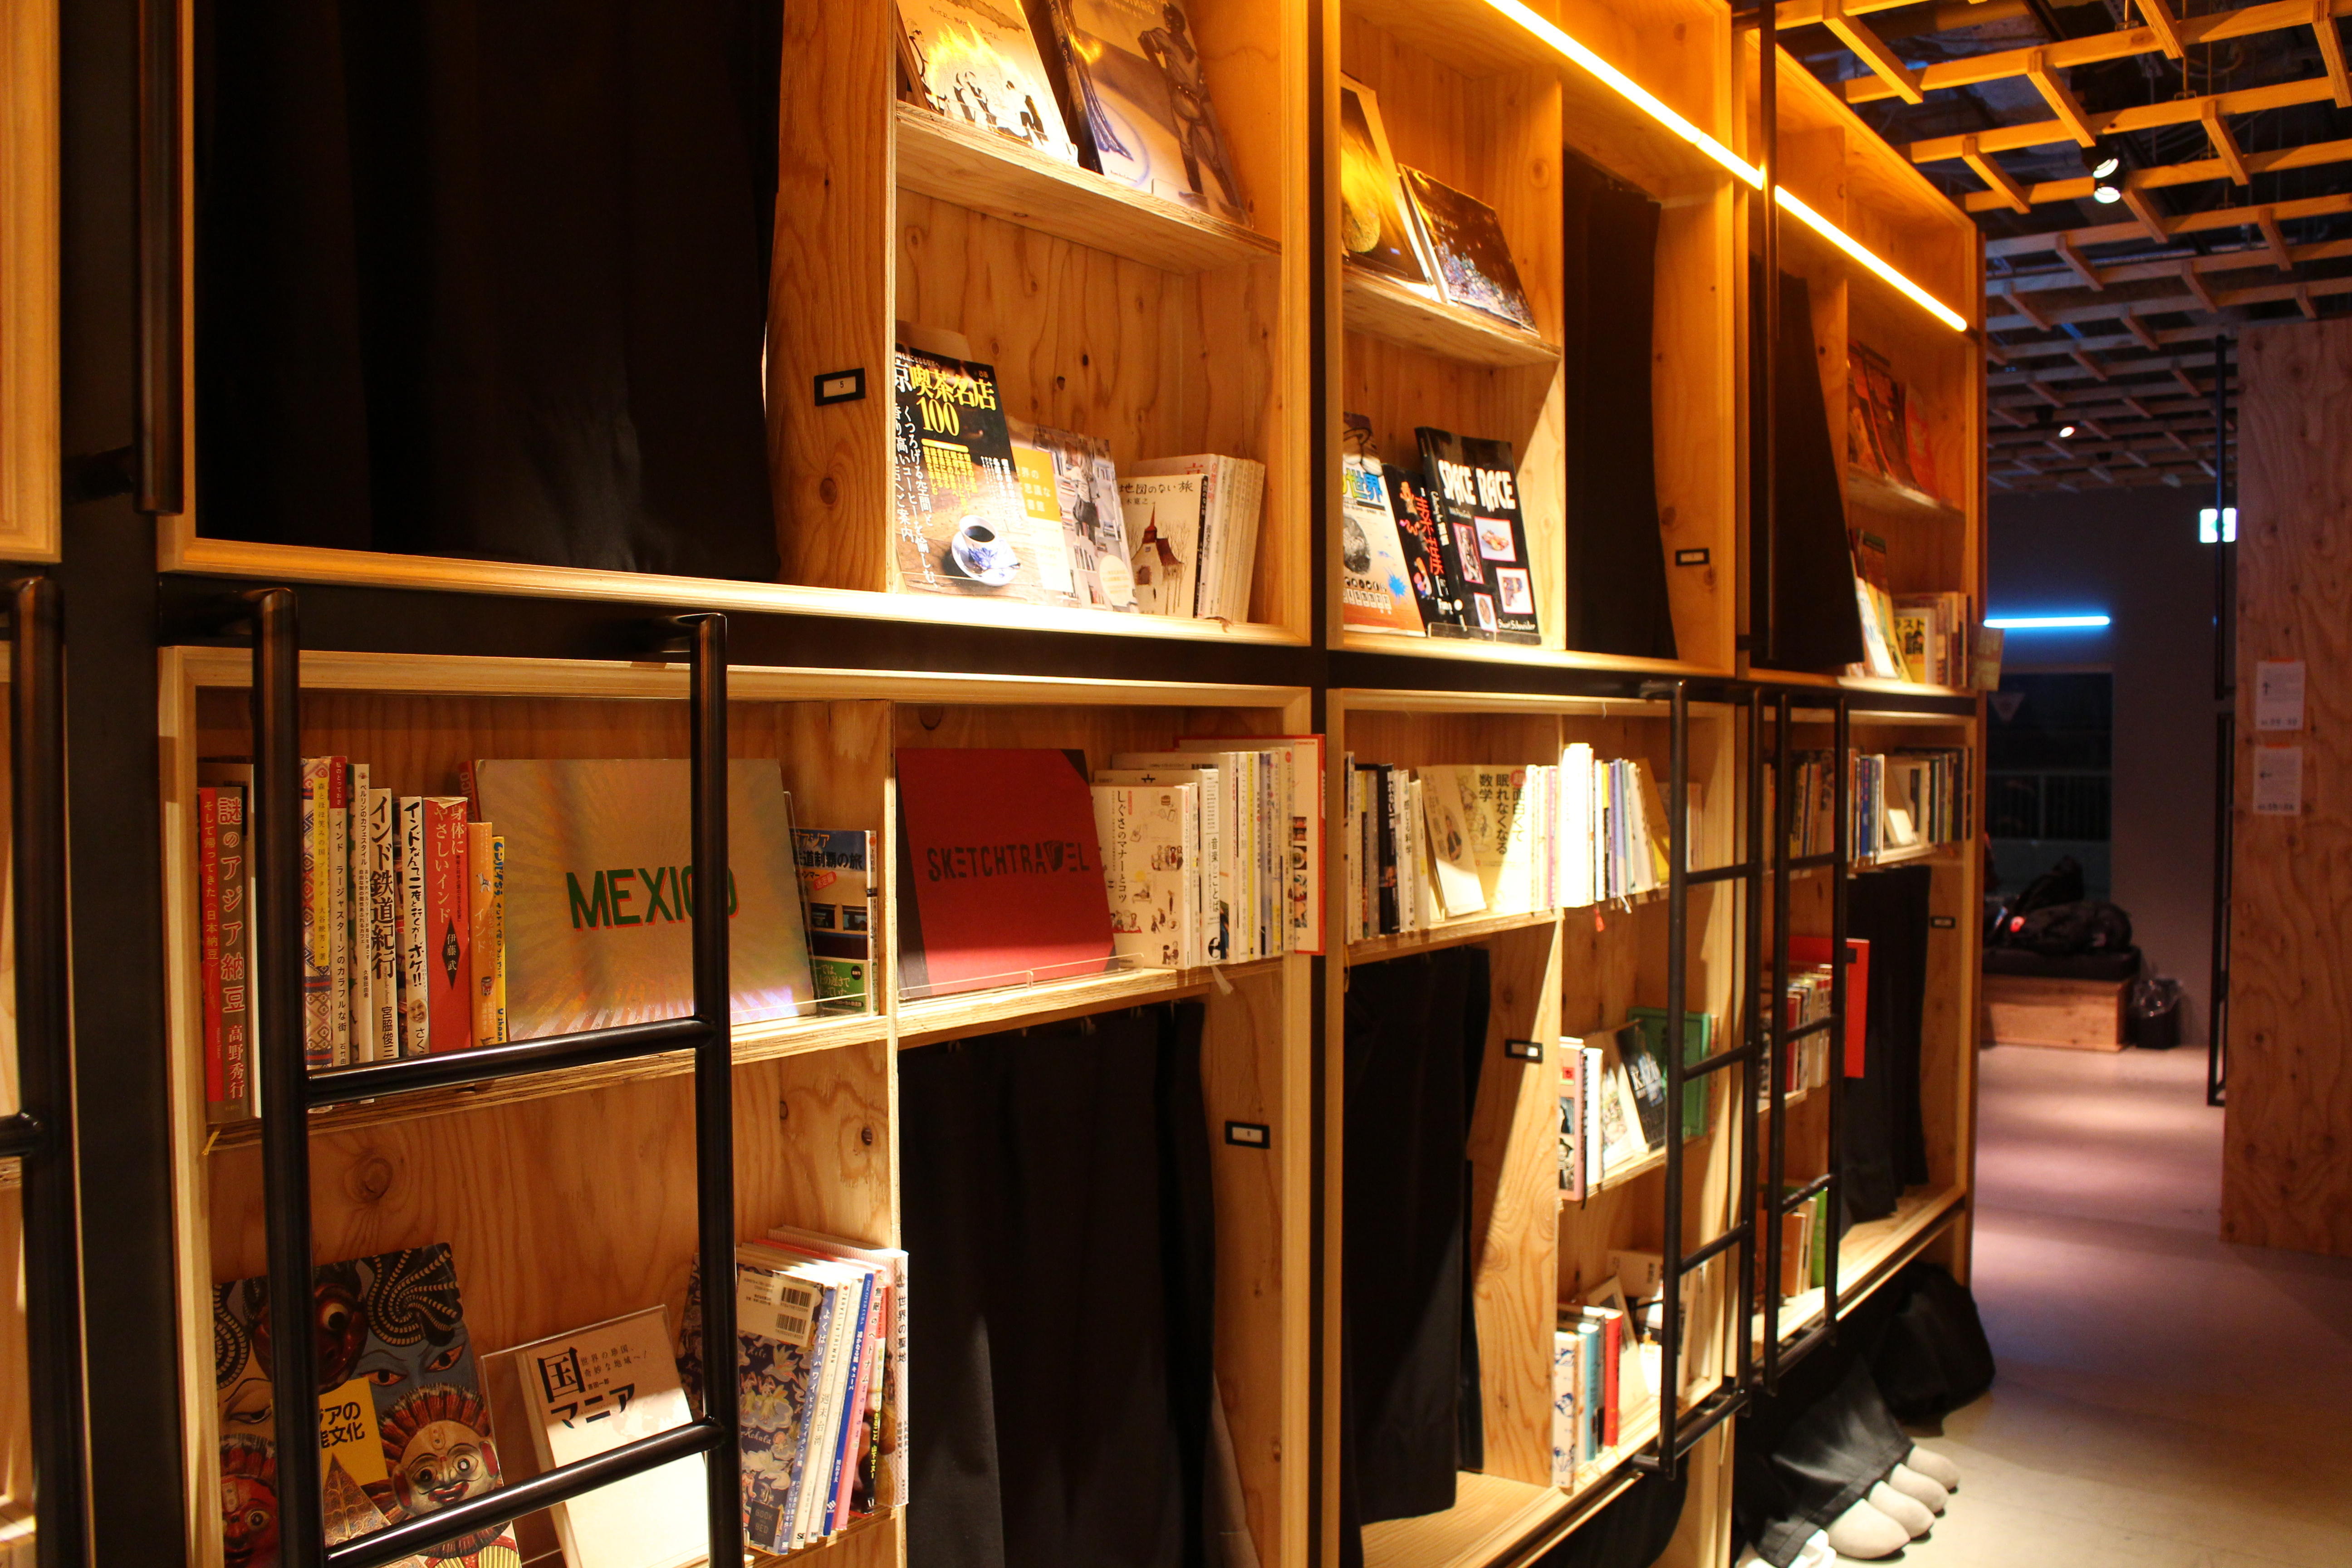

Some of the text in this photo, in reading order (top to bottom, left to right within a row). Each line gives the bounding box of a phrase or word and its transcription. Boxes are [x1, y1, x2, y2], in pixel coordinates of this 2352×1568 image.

[916, 397, 959, 436] 100
[904, 405, 933, 527] くつろげる空間と
[1119, 480, 1193, 495] 地図のない旅
[1343, 467, 1383, 503] 世界
[1438, 459, 1516, 512] SPACE RACE
[1479, 774, 1493, 803] 数学
[1496, 774, 1510, 855] 眠れなくなる
[335, 821, 343, 852] インド
[450, 805, 465, 855] 身体に
[1117, 790, 1127, 903] しぐさのマナーとコツ
[370, 796, 396, 980] インド鉄道紀行
[434, 808, 451, 923] やさしいインド
[218, 797, 245, 1013] 謎のアジア納豆
[474, 908, 486, 953] インド
[336, 866, 347, 1032] ラージャスターンのカラフルな街
[447, 934, 457, 971] 伊藤武
[382, 1006, 394, 1058] 宮脇俊三
[415, 1028, 426, 1054] さく
[228, 1024, 245, 1099] 高野秀行
[810, 1309, 830, 1393] よくばりハワイ
[897, 1295, 906, 1362] 世界の聖地
[537, 1347, 586, 1403] 国
[550, 1383, 635, 1429] マニア
[813, 1393, 831, 1446] 週末台湾
[755, 1509, 774, 1520] BOOK
[755, 1523, 769, 1534] BED
